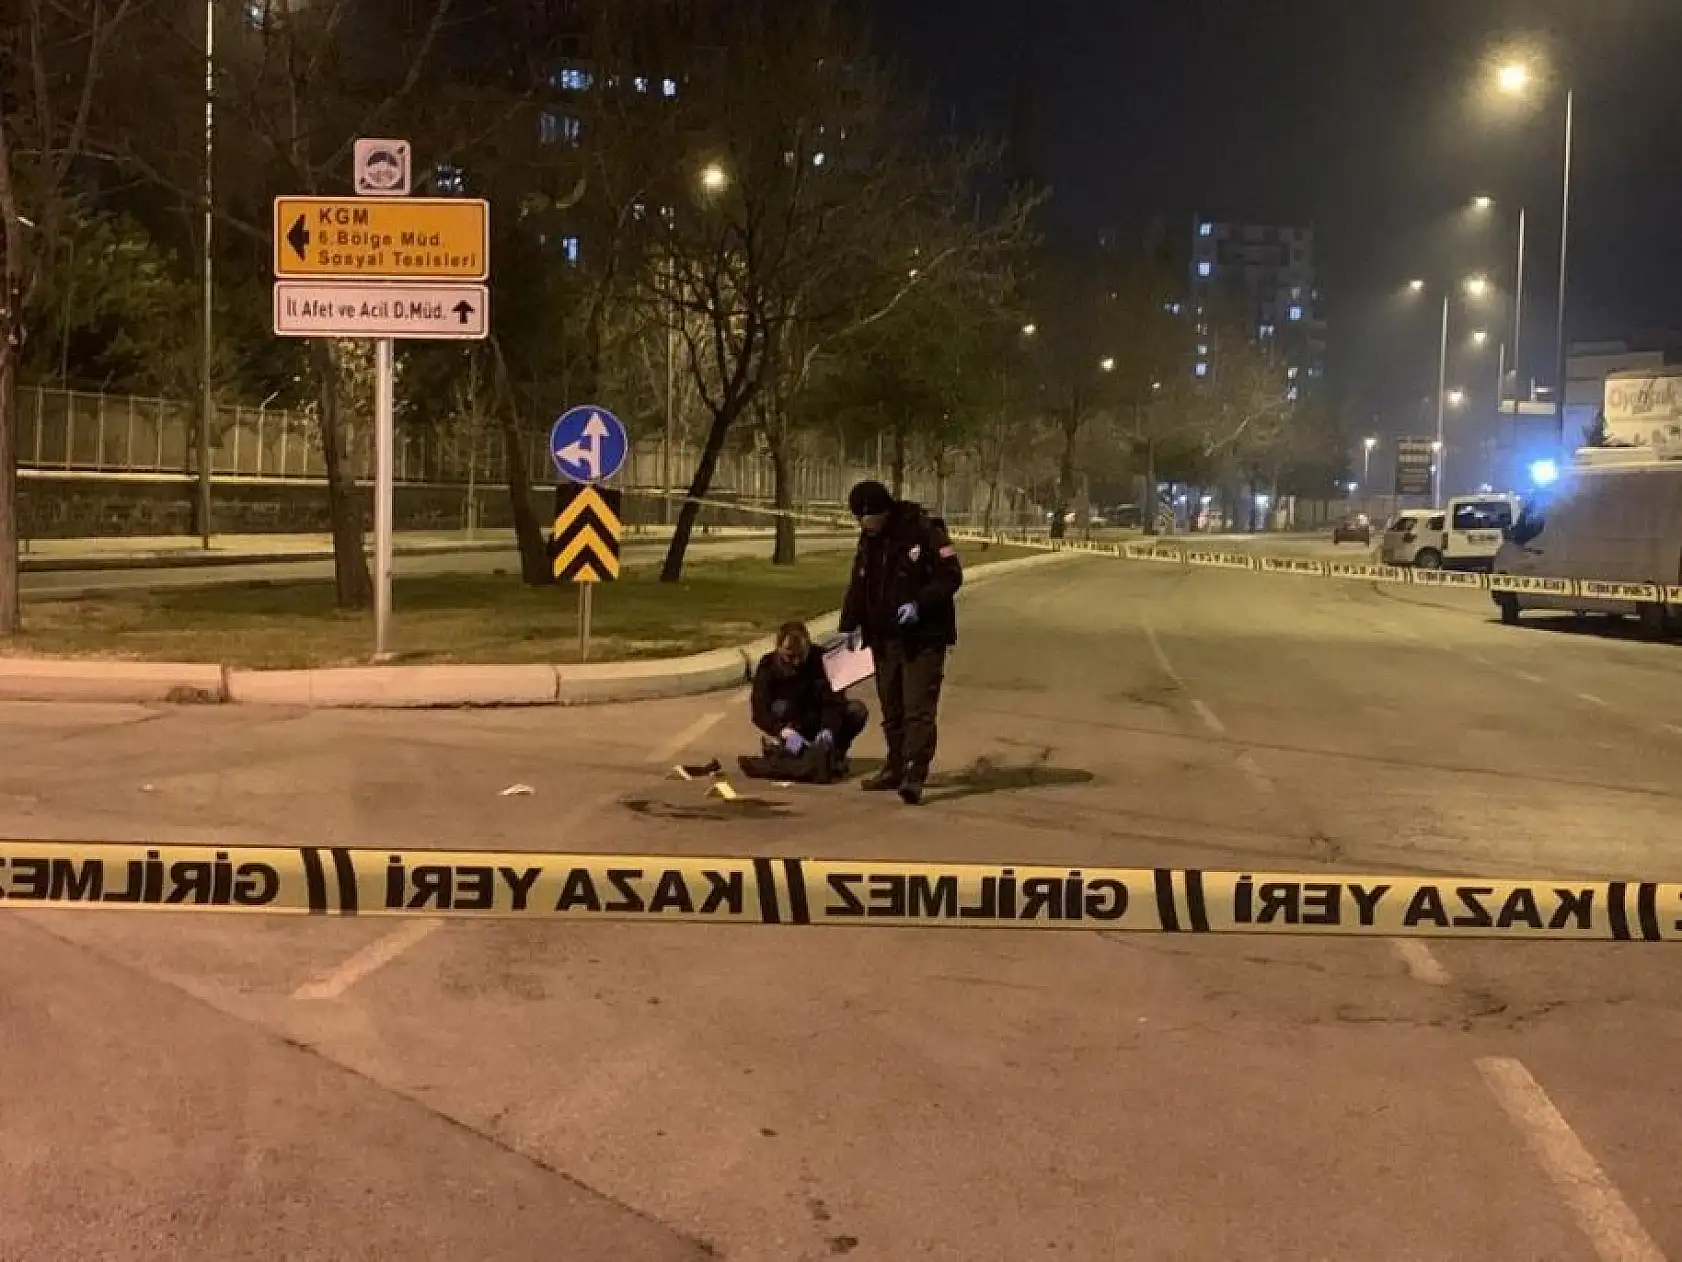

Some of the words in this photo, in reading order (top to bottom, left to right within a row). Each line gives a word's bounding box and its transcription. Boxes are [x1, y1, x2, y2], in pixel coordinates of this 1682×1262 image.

[319, 207, 369, 225] KGM
[318, 249, 384, 268] Sosyal
[393, 251, 477, 268] Tesisleri
[302, 299, 334, 318] Afet
[338, 304, 356, 318] ve
[360, 300, 389, 318] Acil
